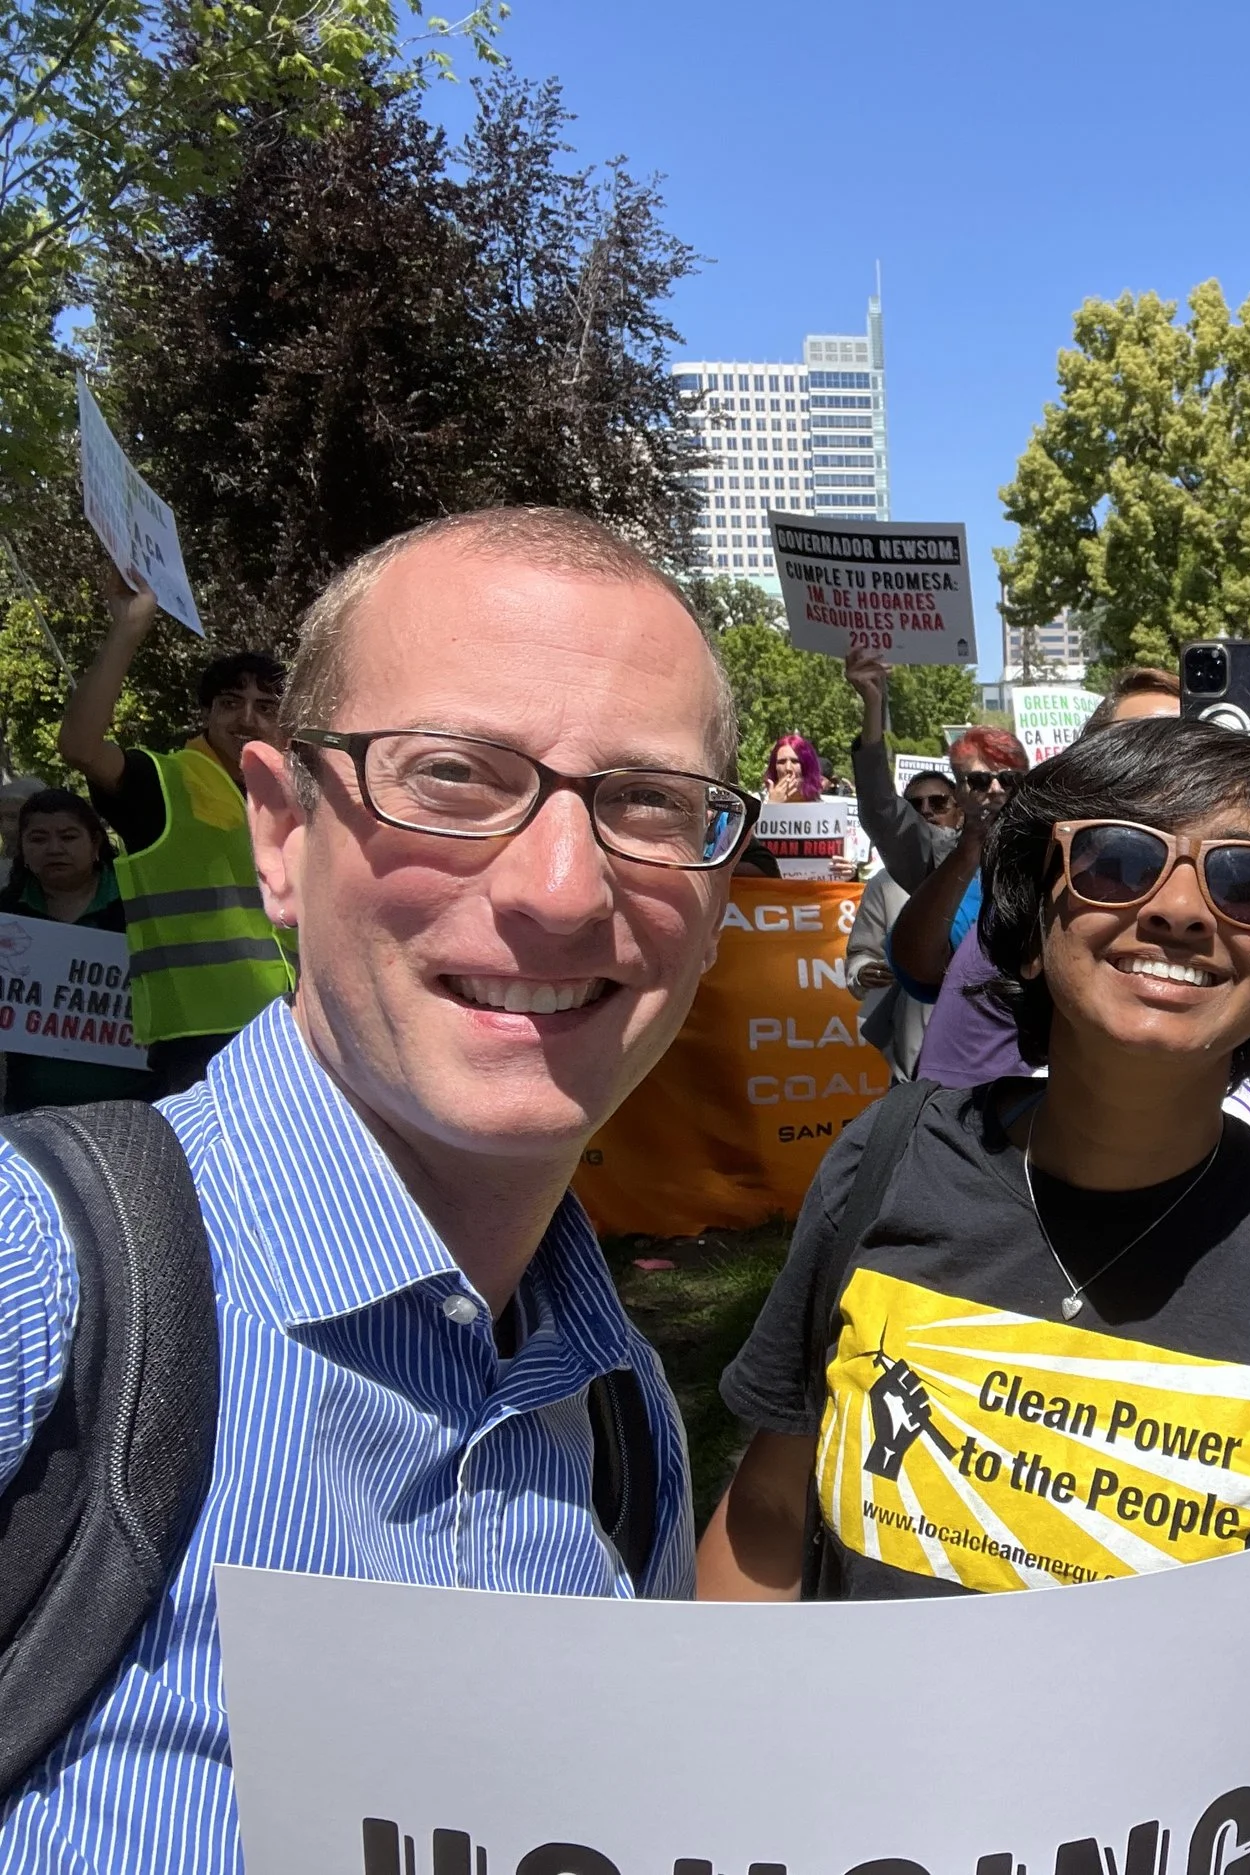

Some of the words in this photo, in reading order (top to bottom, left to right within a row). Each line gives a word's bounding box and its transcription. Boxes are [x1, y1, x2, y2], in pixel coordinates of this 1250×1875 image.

[777, 529, 875, 560] GOVERNADOR
[879, 538, 960, 562] NEWSOM:
[786, 560, 844, 588] CUMPLE
[845, 569, 865, 589] TU
[872, 570, 959, 592] PROMESA:
[833, 591, 850, 609] DE
[857, 592, 936, 612] HOGARES
[806, 603, 895, 631] ASEQUIBLES
[900, 613, 946, 633] PARA
[1024, 694, 1069, 710] GREEN
[1019, 711, 1081, 728] HOUSING
[1024, 730, 1044, 745] CA
[817, 820, 829, 834] IS
[834, 819, 842, 834] A
[764, 840, 799, 856] MAN
[803, 839, 844, 857] RIGHT
[719, 902, 823, 932] ACE
[0, 976, 42, 1007] RA
[25, 1009, 148, 1050] GANANC
[778, 1121, 832, 1143] SAN
[978, 1370, 1098, 1440] Clean
[1105, 1400, 1244, 1470] Power
[956, 1436, 1002, 1482] to
[1009, 1452, 1077, 1502] the
[1086, 1467, 1241, 1541] People
[863, 1499, 1116, 1584] www.localcleanenergy
